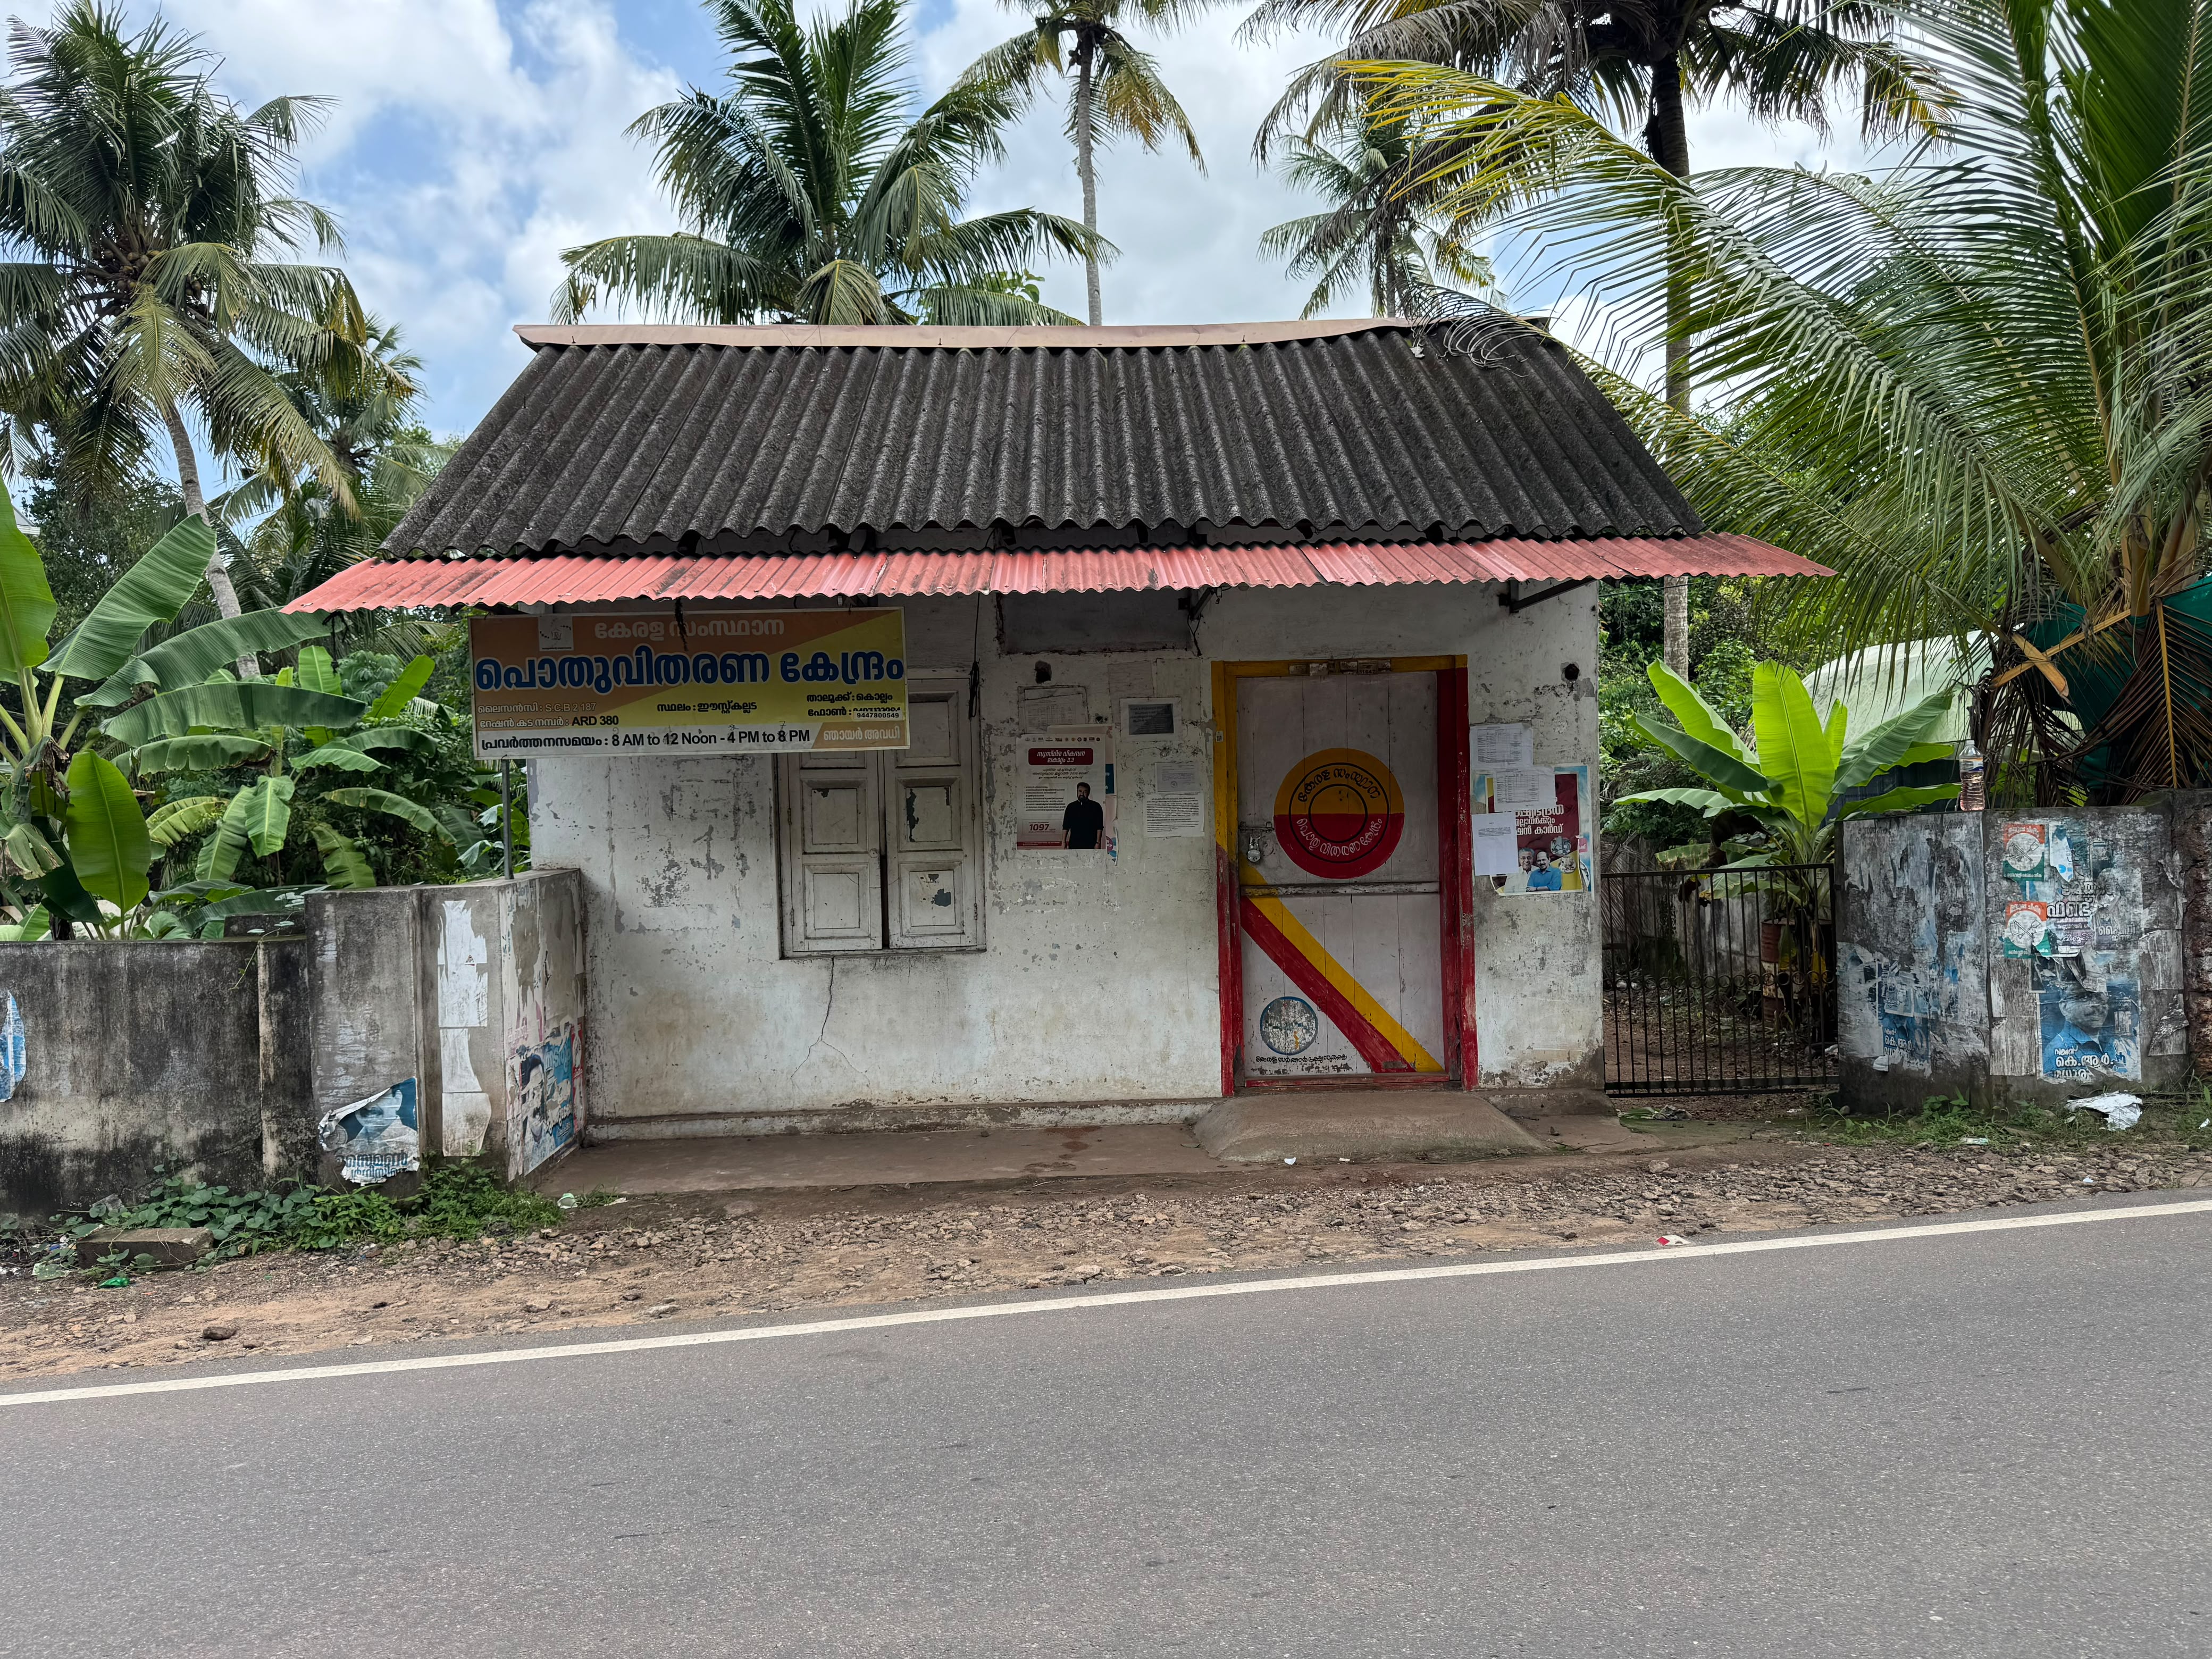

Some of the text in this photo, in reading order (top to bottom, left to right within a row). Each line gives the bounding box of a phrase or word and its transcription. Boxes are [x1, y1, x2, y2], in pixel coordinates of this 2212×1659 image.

[594, 621, 665, 641] കേരള
[477, 646, 904, 694] പൊതുവിതരണ കേന്ദ്രം
[856, 693, 893, 703] കൊല്ലം
[581, 702, 597, 711] 187
[480, 717, 515, 728] റേഷൻ
[571, 716, 598, 726] ARD
[599, 715, 619, 725] 380
[611, 734, 620, 746] 8
[622, 734, 644, 745] AM
[647, 734, 660, 745] to
[663, 733, 678, 744] 12
[682, 732, 717, 744] Noon
[727, 731, 736, 743] 4
[739, 731, 759, 743] PM
[762, 731, 775, 743] to
[778, 730, 786, 742] 8
[789, 730, 810, 742] PM
[823, 725, 901, 741] ഞായർ അവധി
[1534, 823, 1564, 834] കാർഡ്
